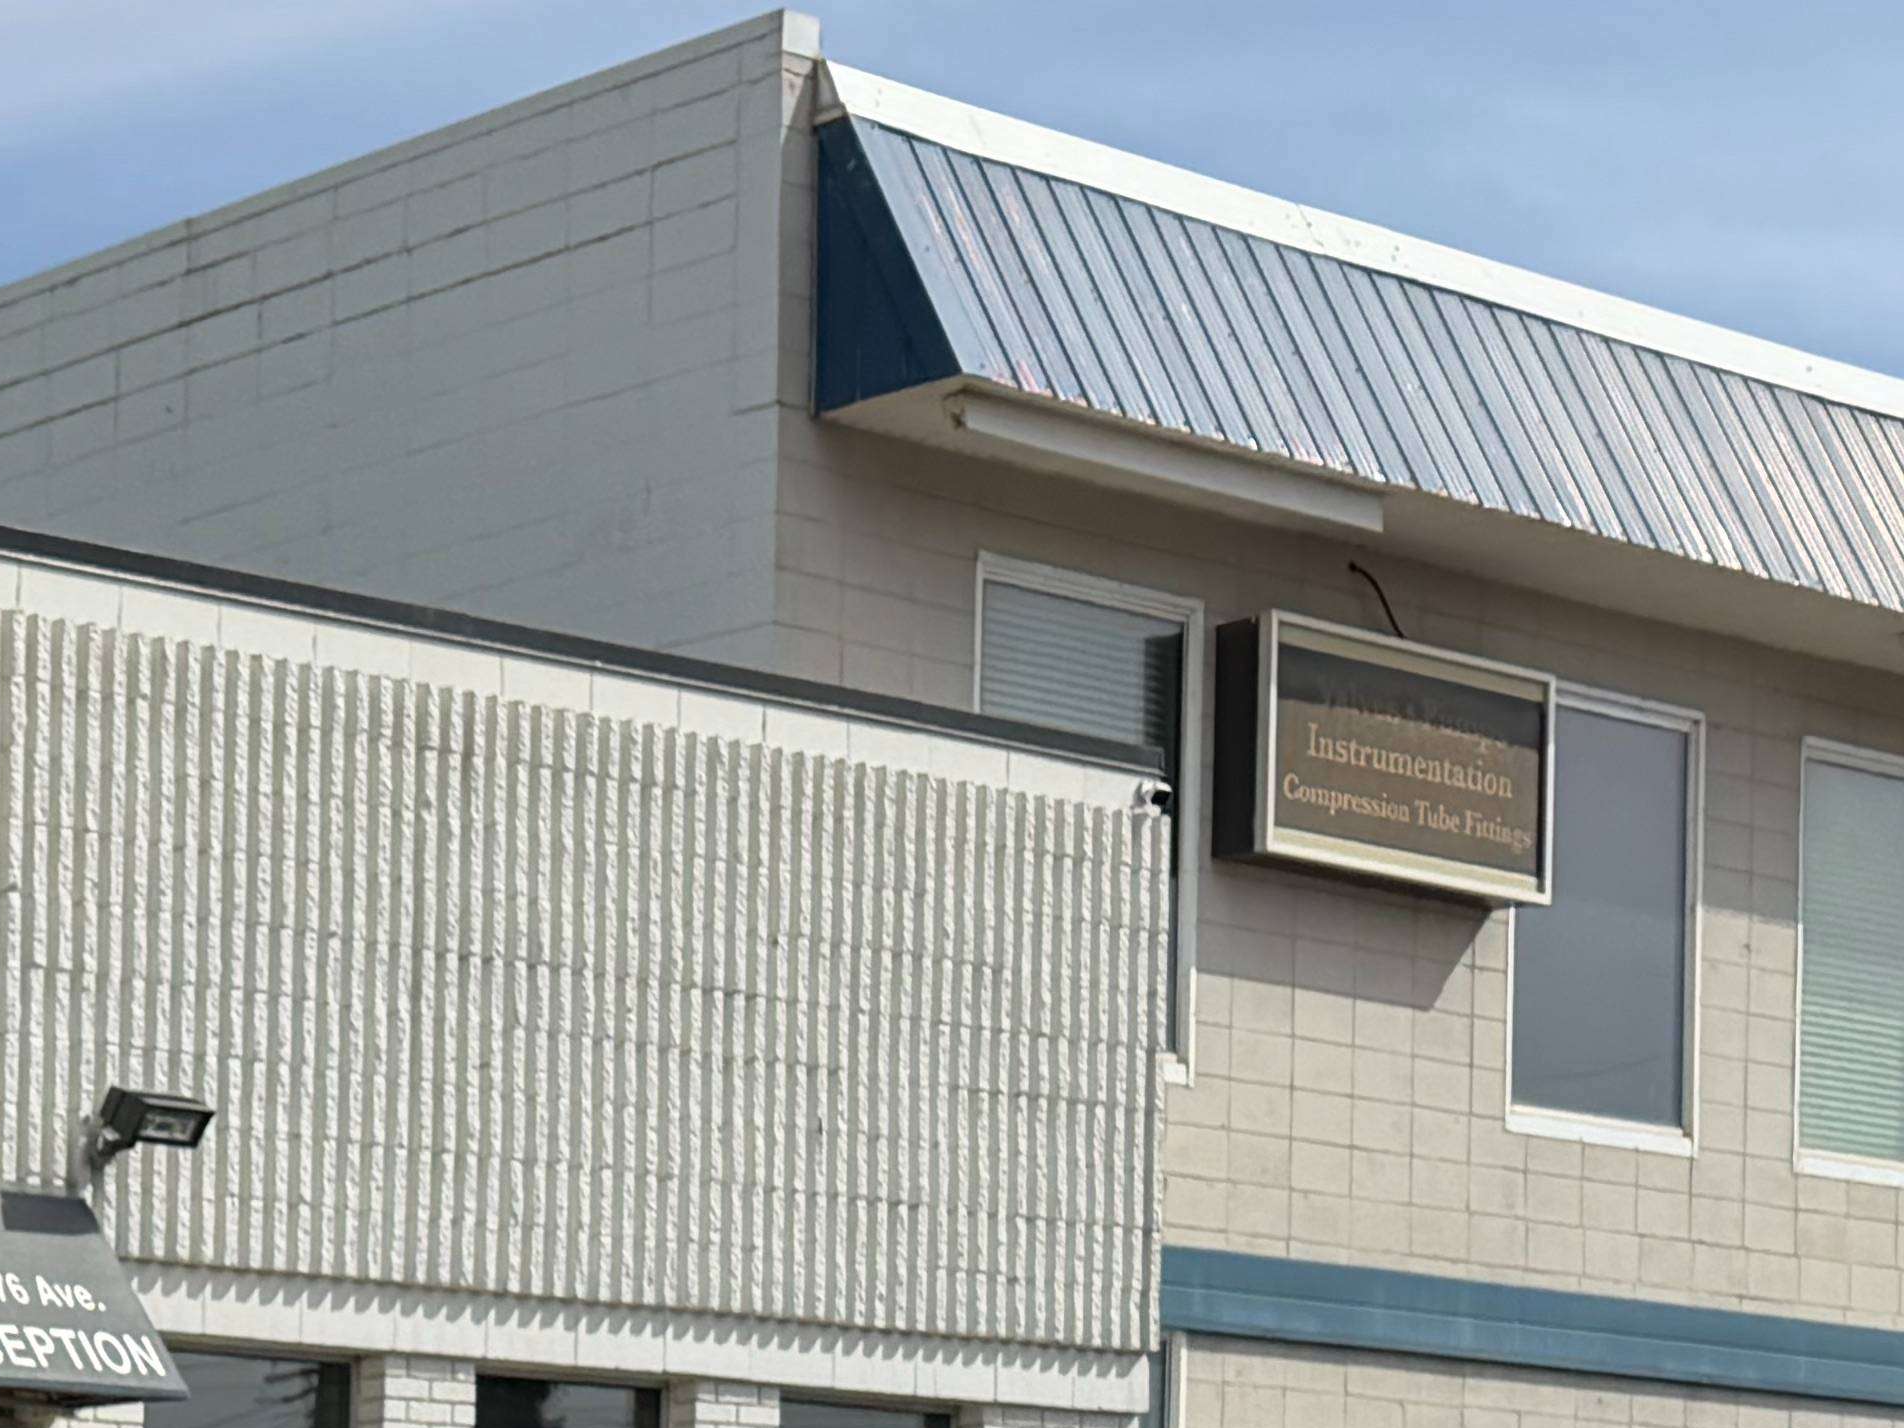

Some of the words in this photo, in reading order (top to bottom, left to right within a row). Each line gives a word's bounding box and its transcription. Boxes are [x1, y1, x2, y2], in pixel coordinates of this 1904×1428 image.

[1306, 722, 1514, 799] Instrumentation
[1282, 772, 1411, 822] Compression
[1414, 799, 1461, 834] Tube
[1464, 808, 1533, 855] Fittings
[35, 1274, 106, 1312] Ave.
